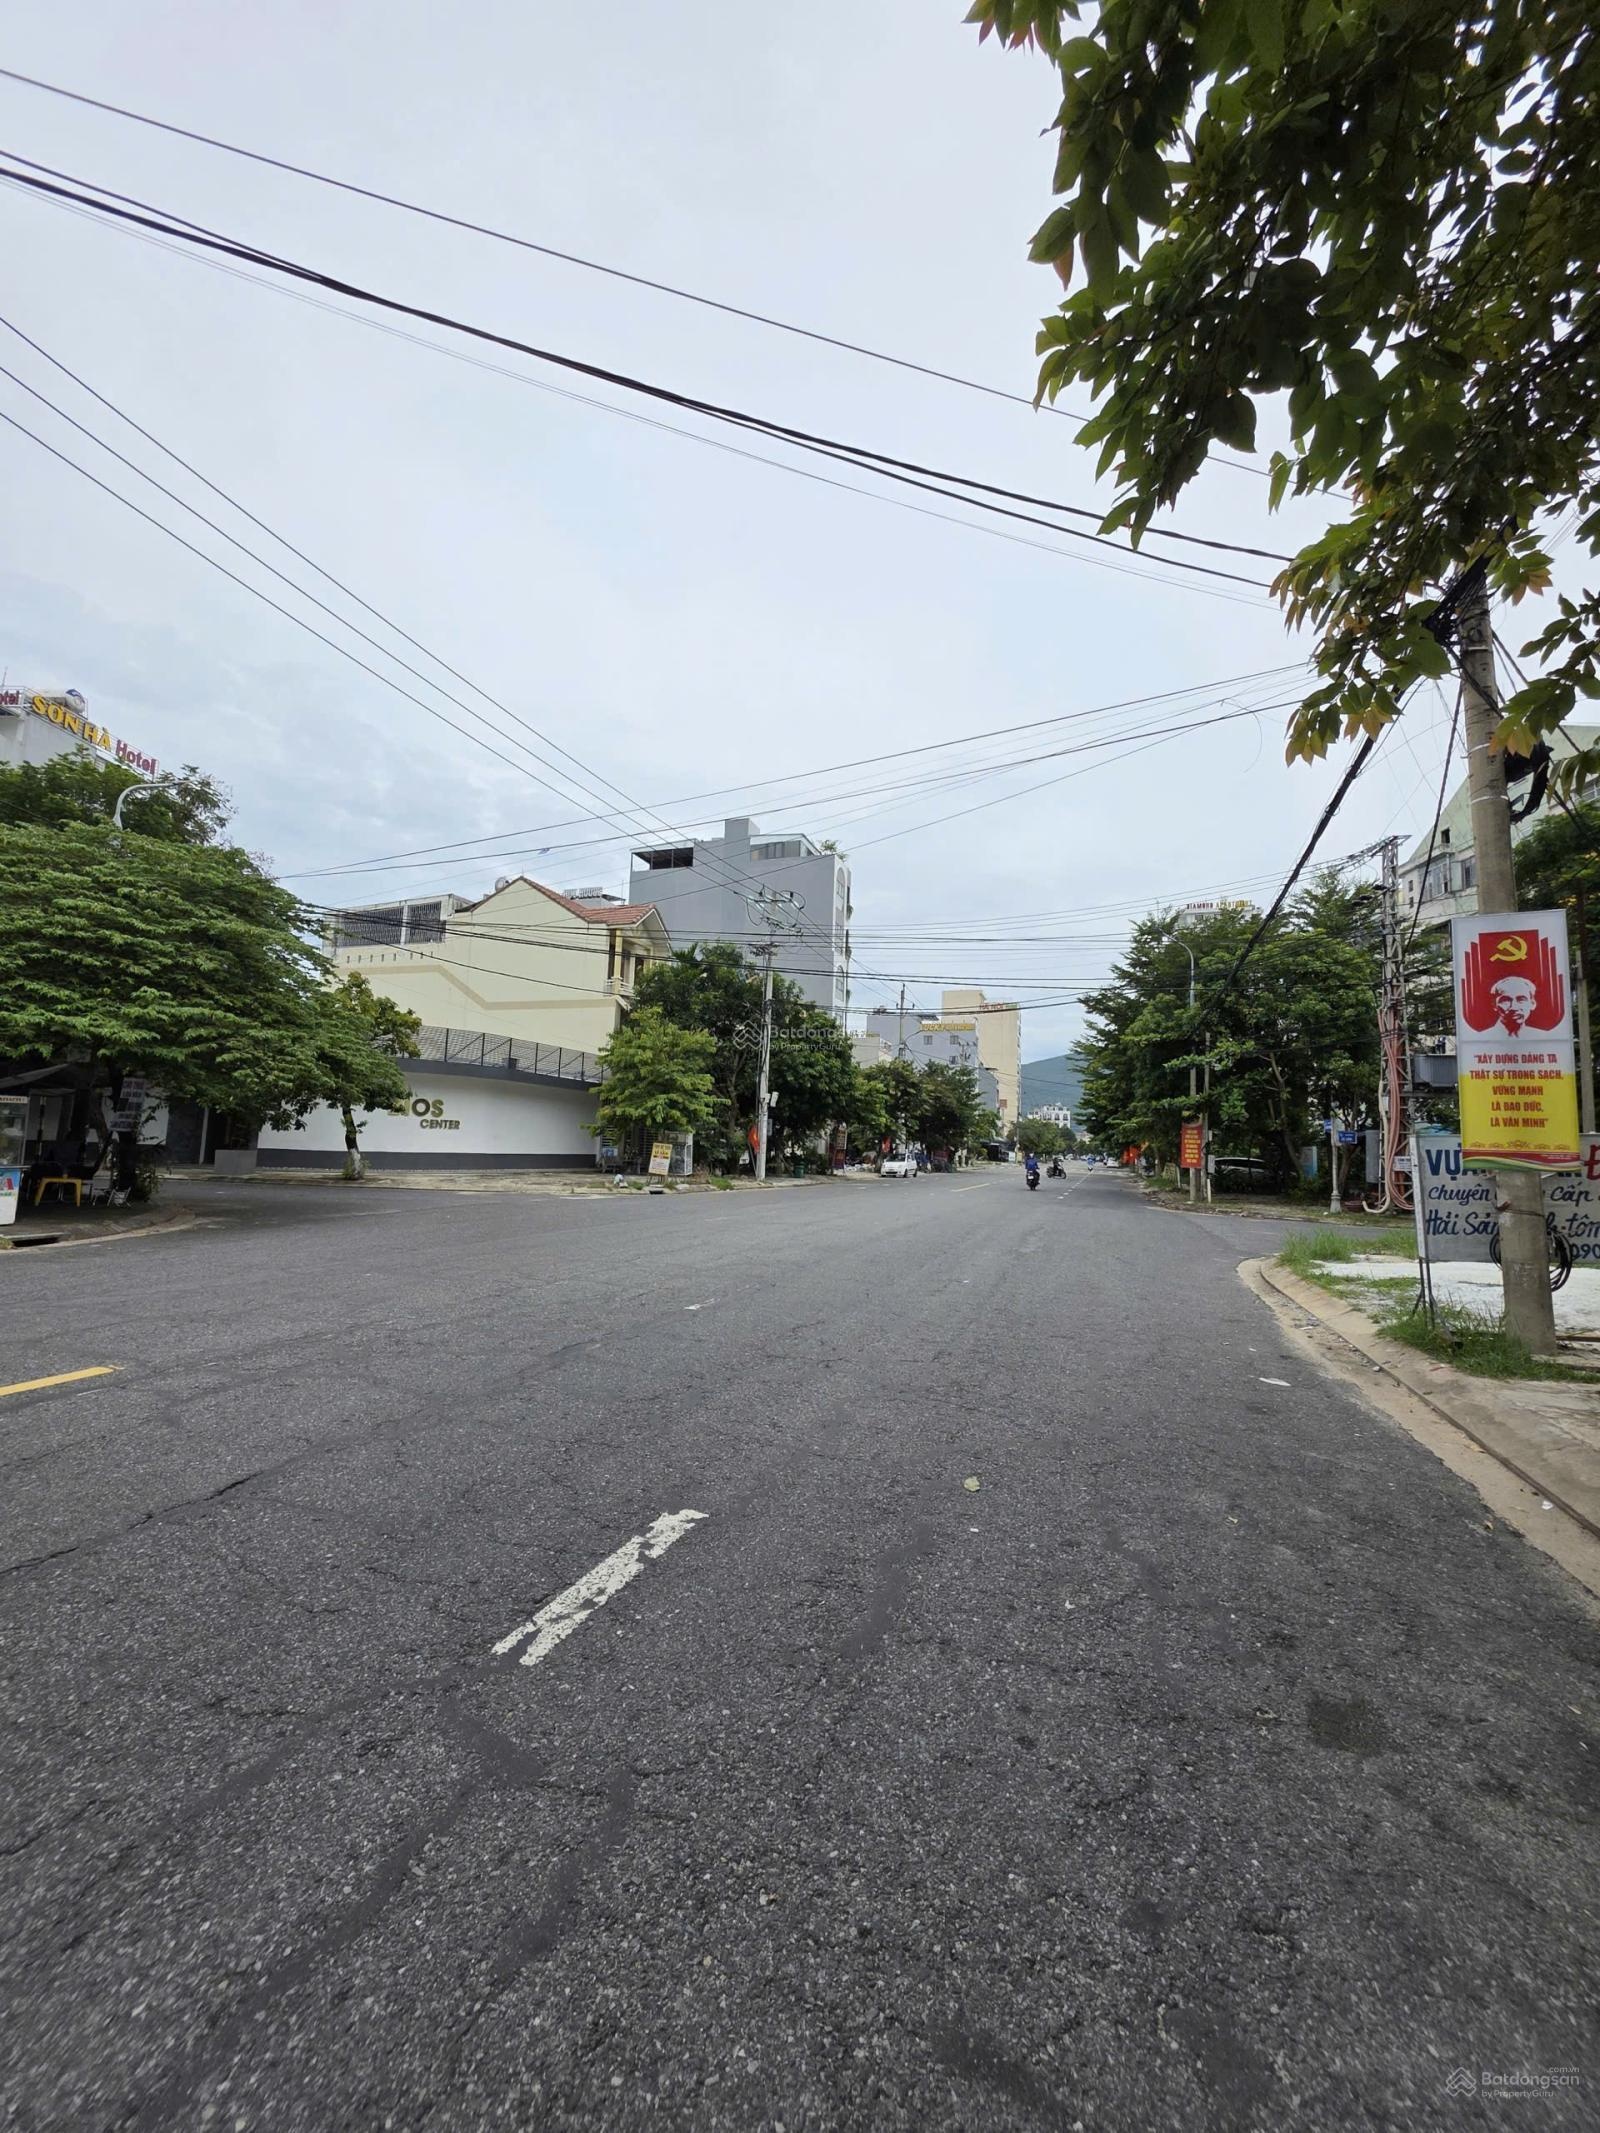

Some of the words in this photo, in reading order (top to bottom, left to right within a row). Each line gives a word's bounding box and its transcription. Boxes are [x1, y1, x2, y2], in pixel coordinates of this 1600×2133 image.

[115, 739, 157, 774] Hotel
[1547, 1053, 1558, 1064] TA
[1507, 1070, 1536, 1080] TRONG
[1491, 1101, 1501, 1112] LÀ
[420, 1119, 460, 1130] CENTER
[1490, 1117, 1500, 1128] LÀ
